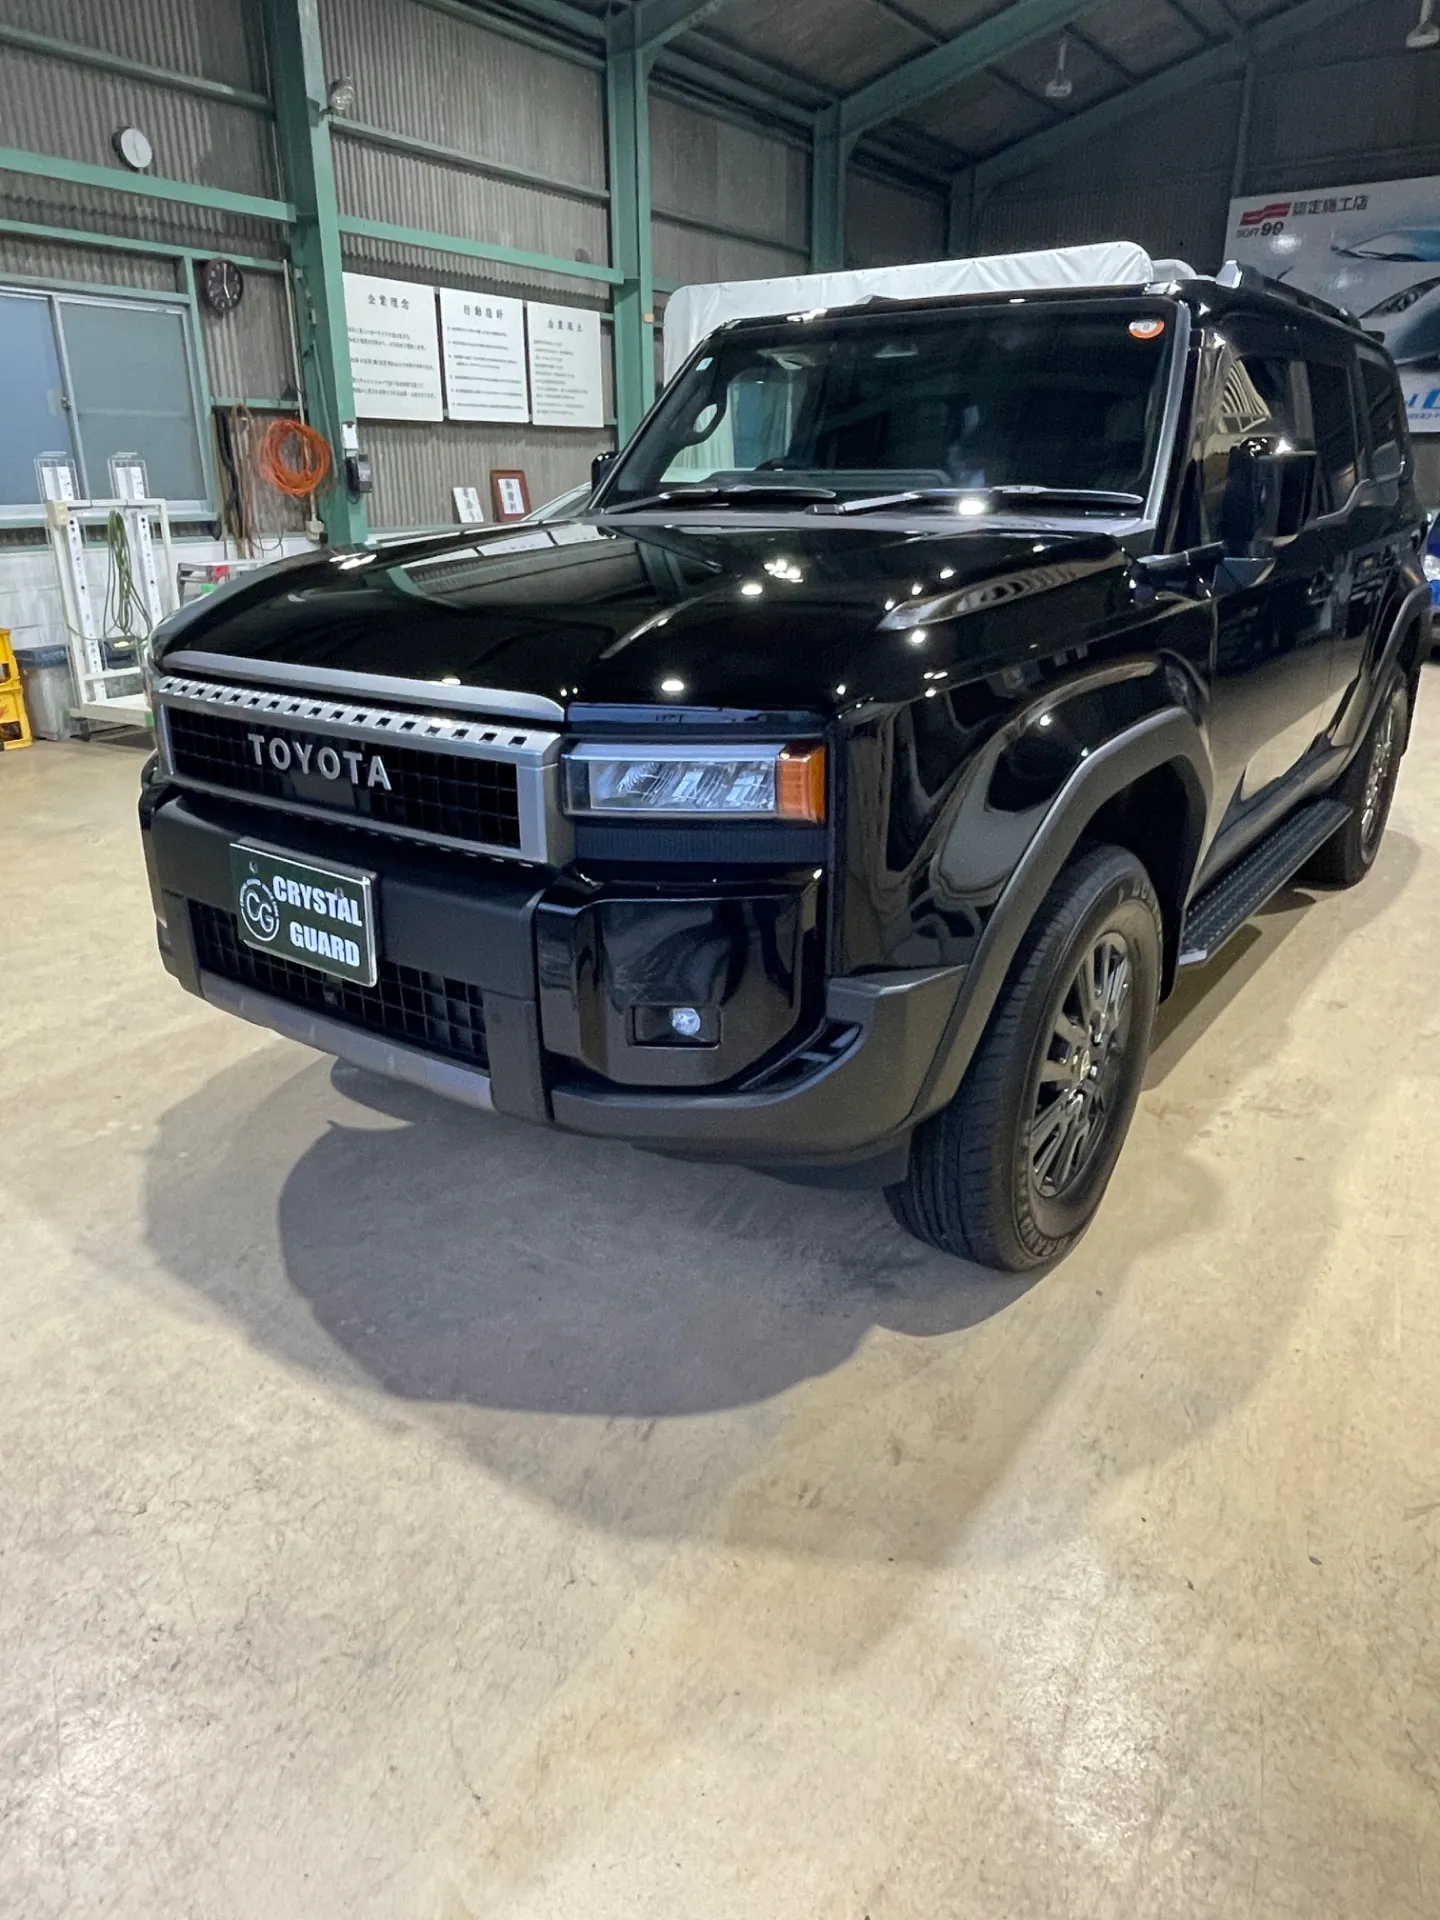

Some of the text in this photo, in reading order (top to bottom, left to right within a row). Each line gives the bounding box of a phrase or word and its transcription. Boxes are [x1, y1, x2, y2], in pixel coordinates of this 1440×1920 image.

[247, 733, 393, 791] TOYOTA
[272, 875, 363, 927] CRYSTAL
[289, 921, 360, 968] GUARD
